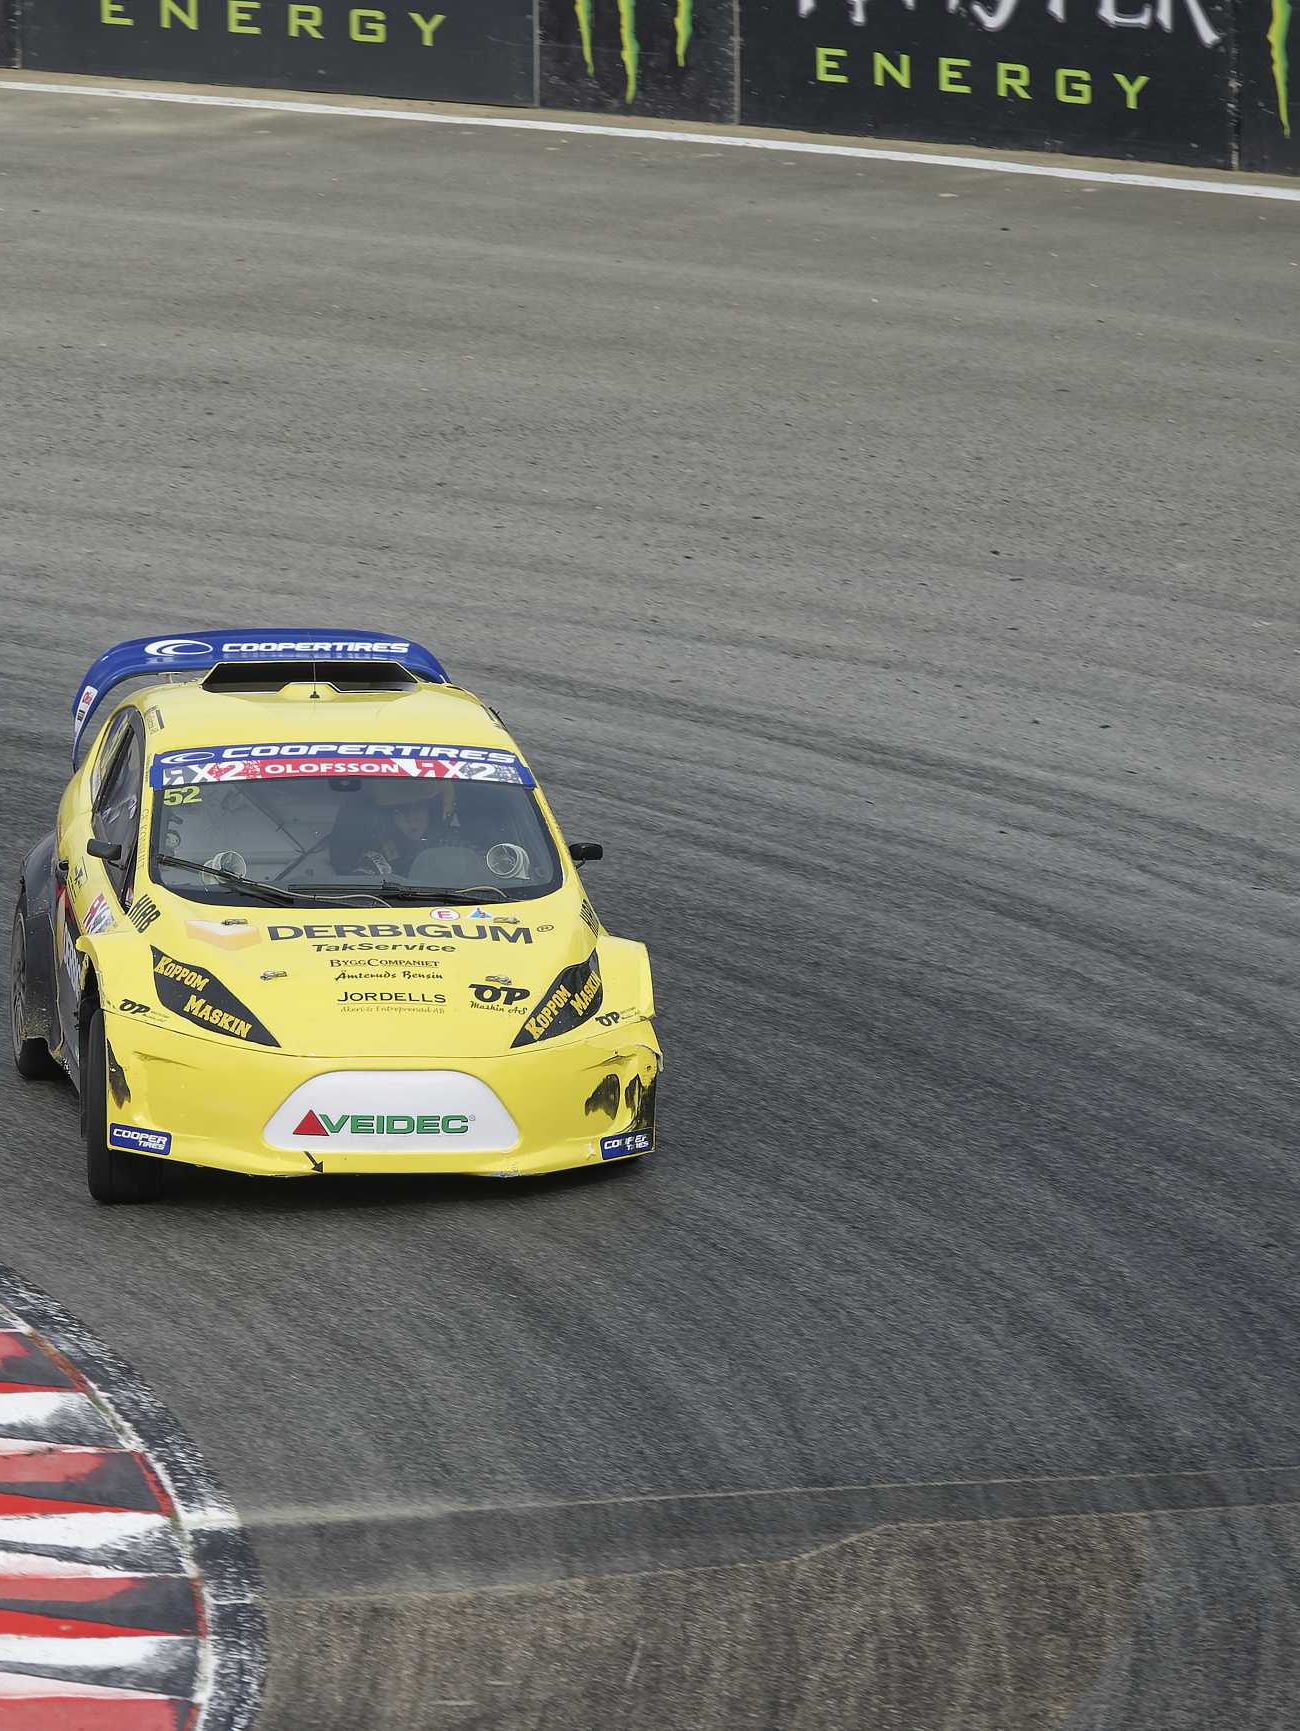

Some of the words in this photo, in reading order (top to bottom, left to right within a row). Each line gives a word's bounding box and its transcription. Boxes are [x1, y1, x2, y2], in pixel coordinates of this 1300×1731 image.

[100, 0, 446, 47] ENERGY
[814, 47, 1150, 111] ENERGY
[221, 642, 410, 653] COOPERTIRES
[220, 744, 515, 765] COOPERTIRES
[264, 762, 401, 775] OLOFSSON
[163, 786, 203, 806] 52
[267, 924, 534, 944] DERBIGUM
[311, 942, 456, 952] TakService
[337, 991, 447, 1004] JORDELLS
[319, 1114, 469, 1135] VEIDEC
[112, 1127, 169, 1146] COOPER
